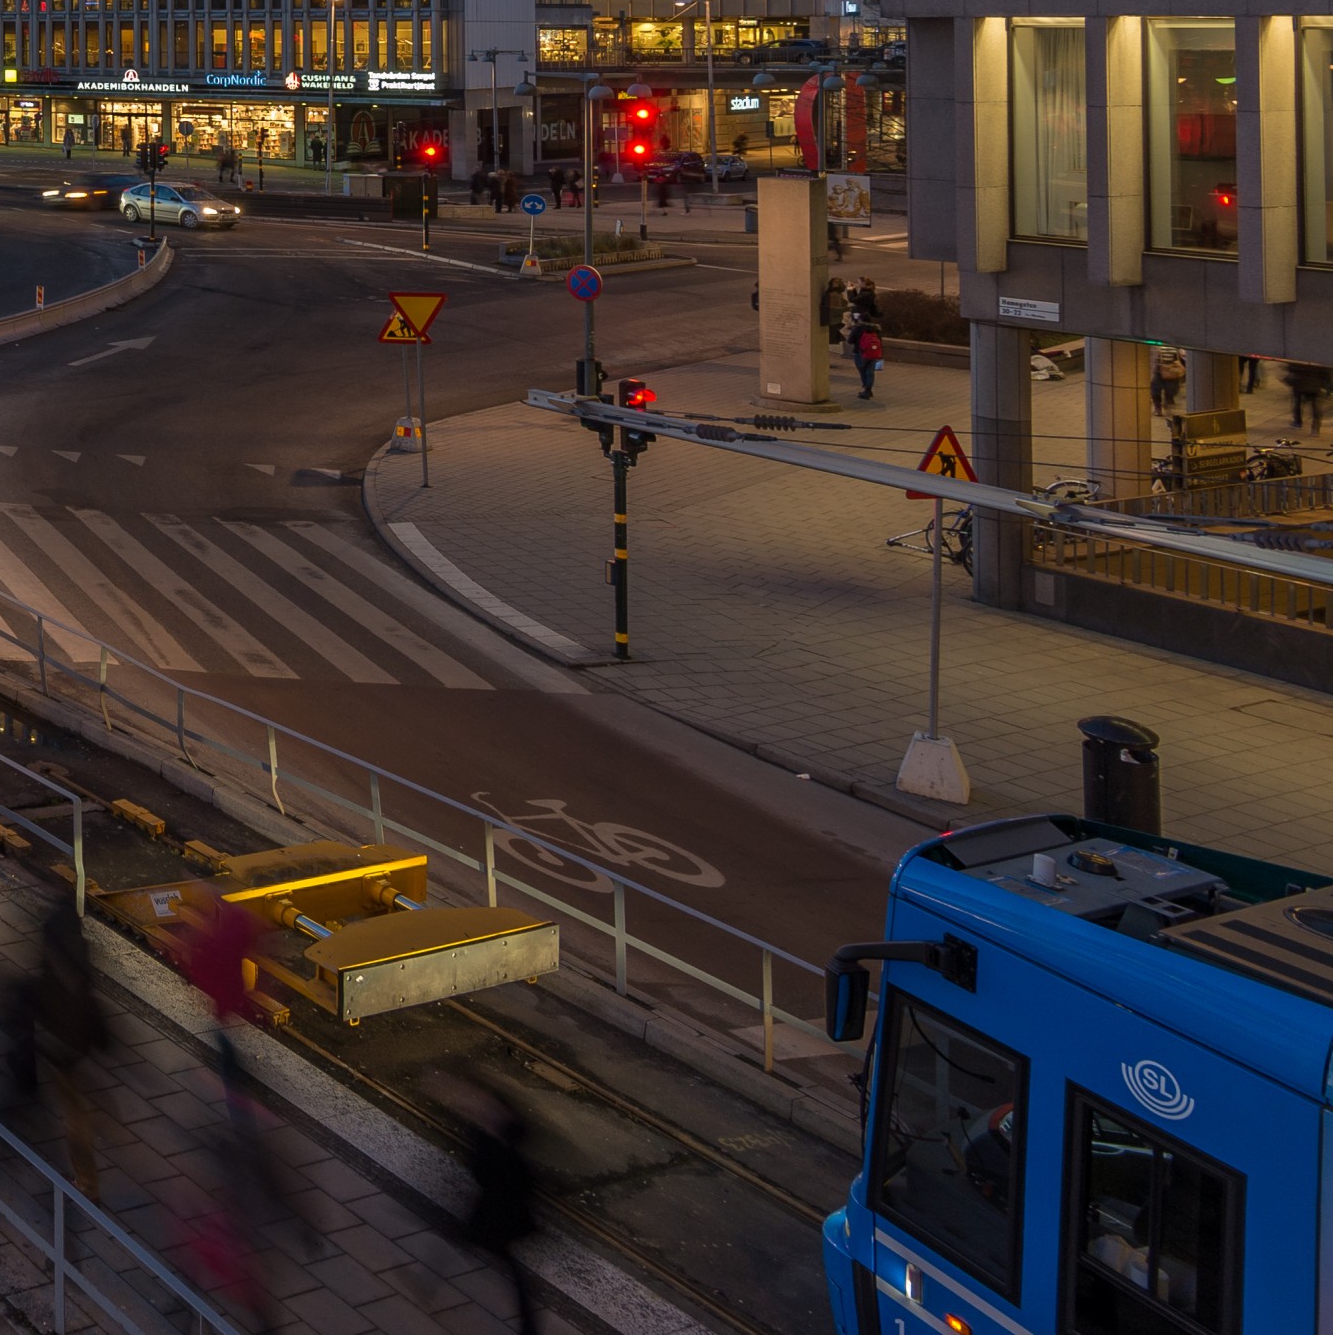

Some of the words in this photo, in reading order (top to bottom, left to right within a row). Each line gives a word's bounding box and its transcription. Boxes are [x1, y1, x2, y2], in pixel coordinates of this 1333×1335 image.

[206, 70, 267, 88] CorpNordic
[301, 81, 355, 90] WAKEIELD
[349, 75, 357, 83] &
[77, 81, 189, 93] AKADEMIBOKHANDELN
[730, 96, 760, 111] stadium
[399, 129, 449, 151] AKADE
[1142, 1068, 1173, 1100] SL
